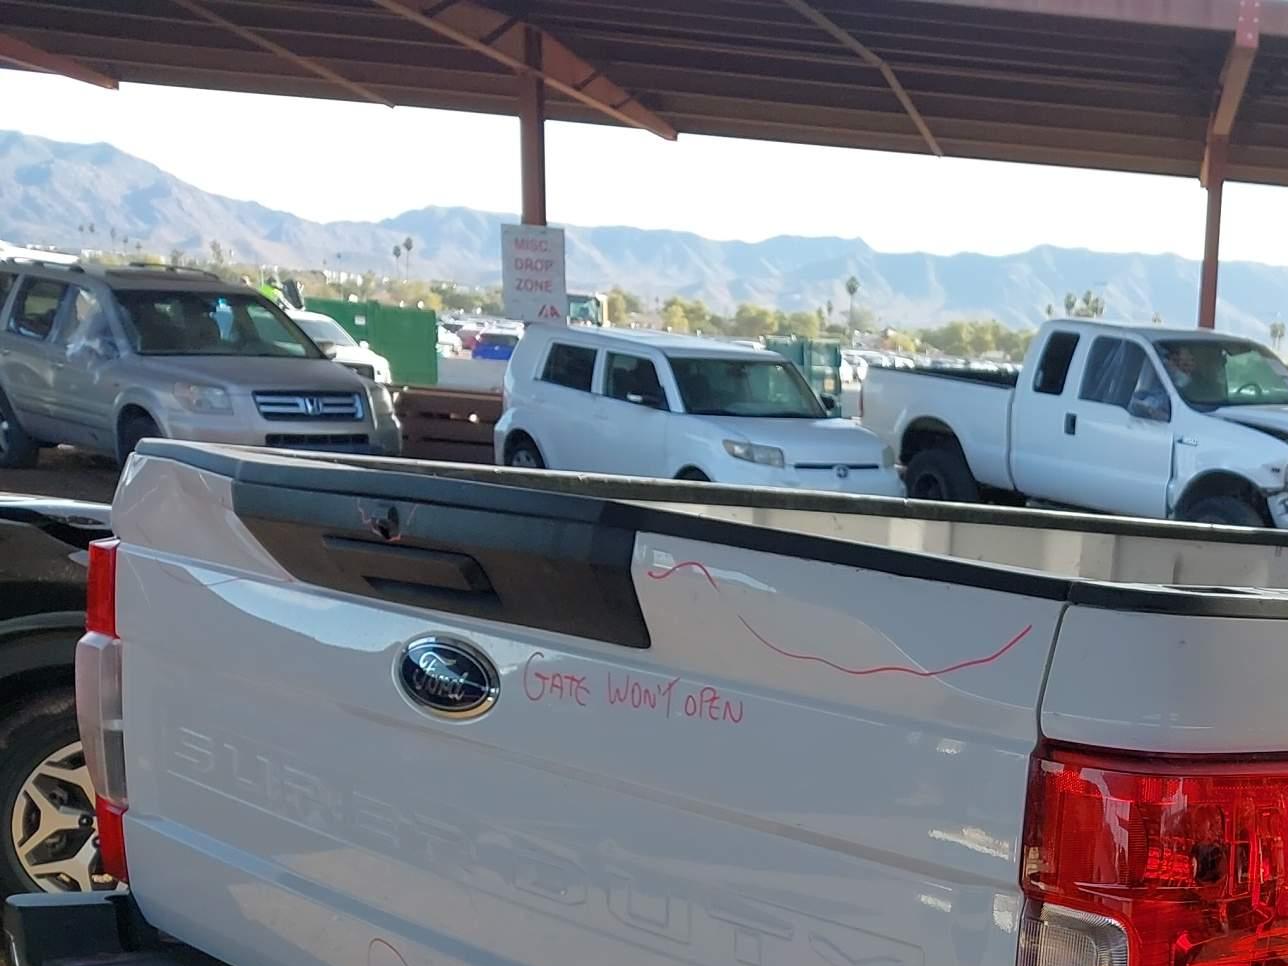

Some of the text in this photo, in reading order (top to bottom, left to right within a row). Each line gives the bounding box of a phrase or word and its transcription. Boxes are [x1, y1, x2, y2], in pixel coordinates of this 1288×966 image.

[513, 258, 553, 272] DROP
[515, 279, 553, 293] ZONE
[411, 651, 488, 701] Ford
[523, 651, 590, 706] GATE
